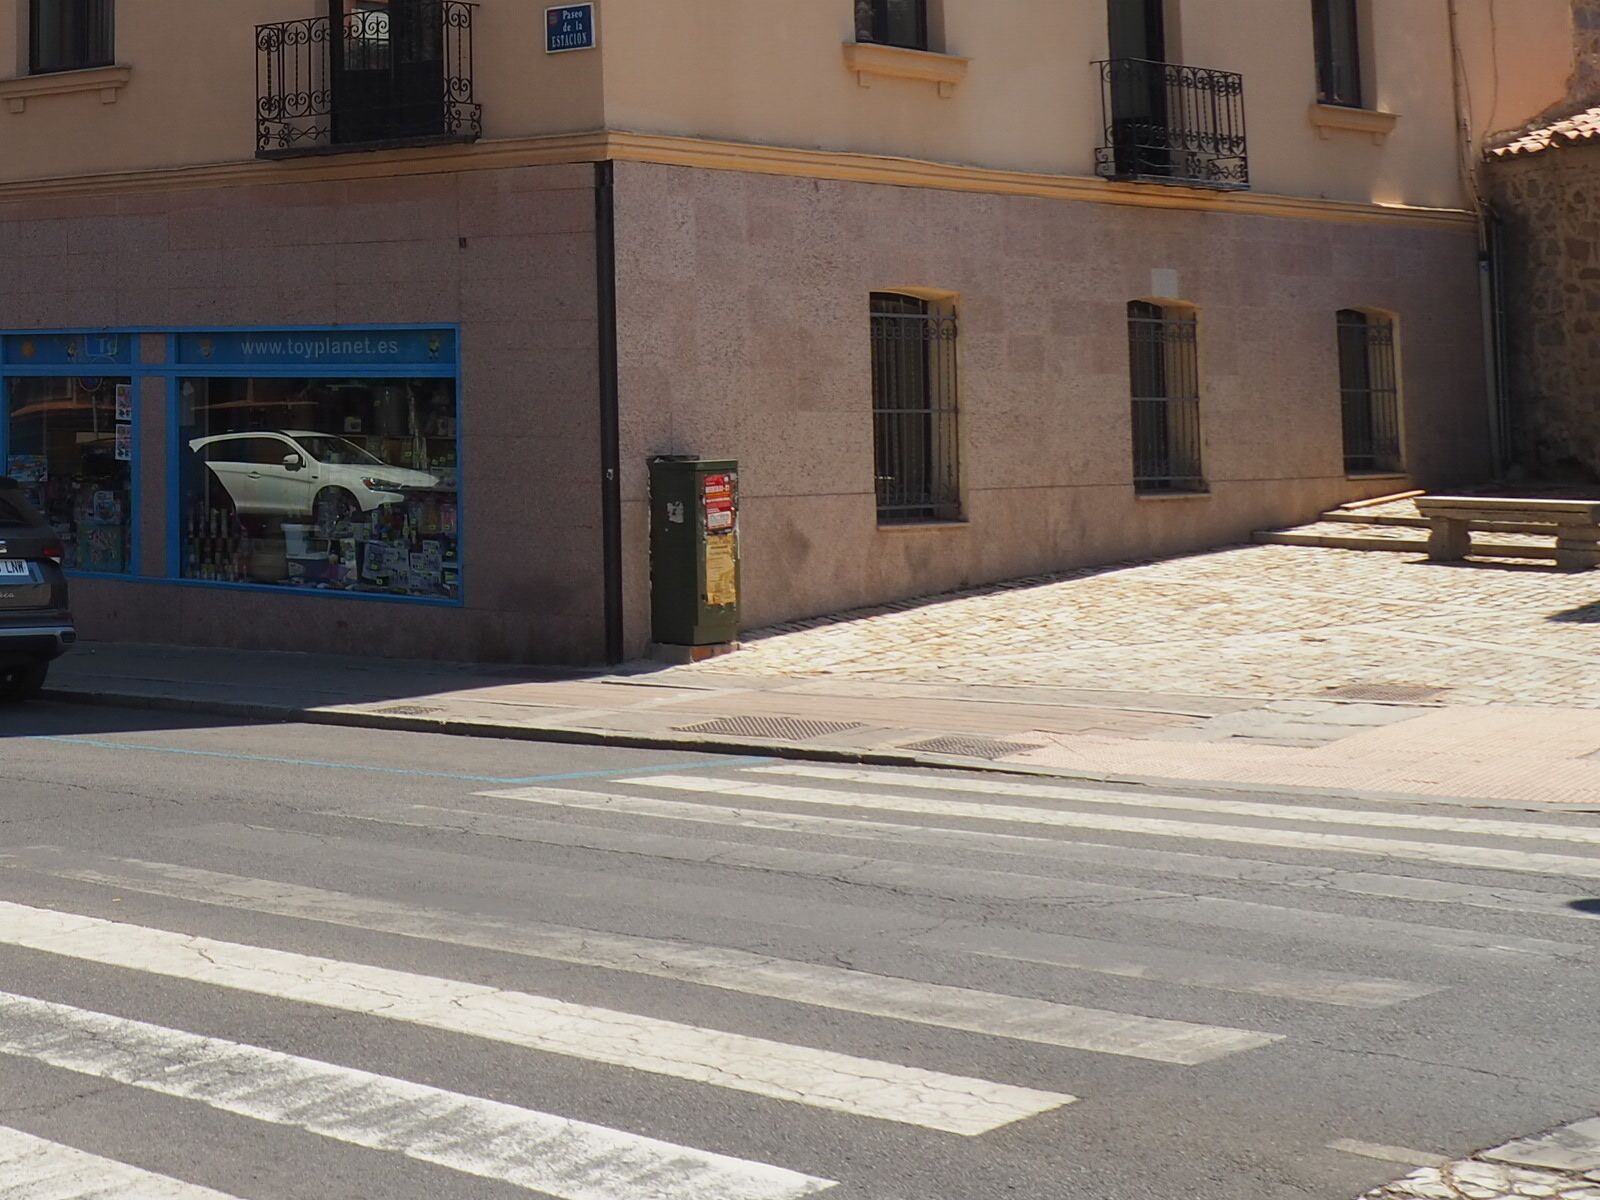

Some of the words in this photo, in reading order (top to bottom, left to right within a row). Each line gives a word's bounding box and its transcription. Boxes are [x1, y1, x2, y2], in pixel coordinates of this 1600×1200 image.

[562, 10, 583, 20] Paseo
[563, 22, 571, 33] de
[575, 20, 583, 31] la
[240, 337, 399, 359] www.toyplanet.es
